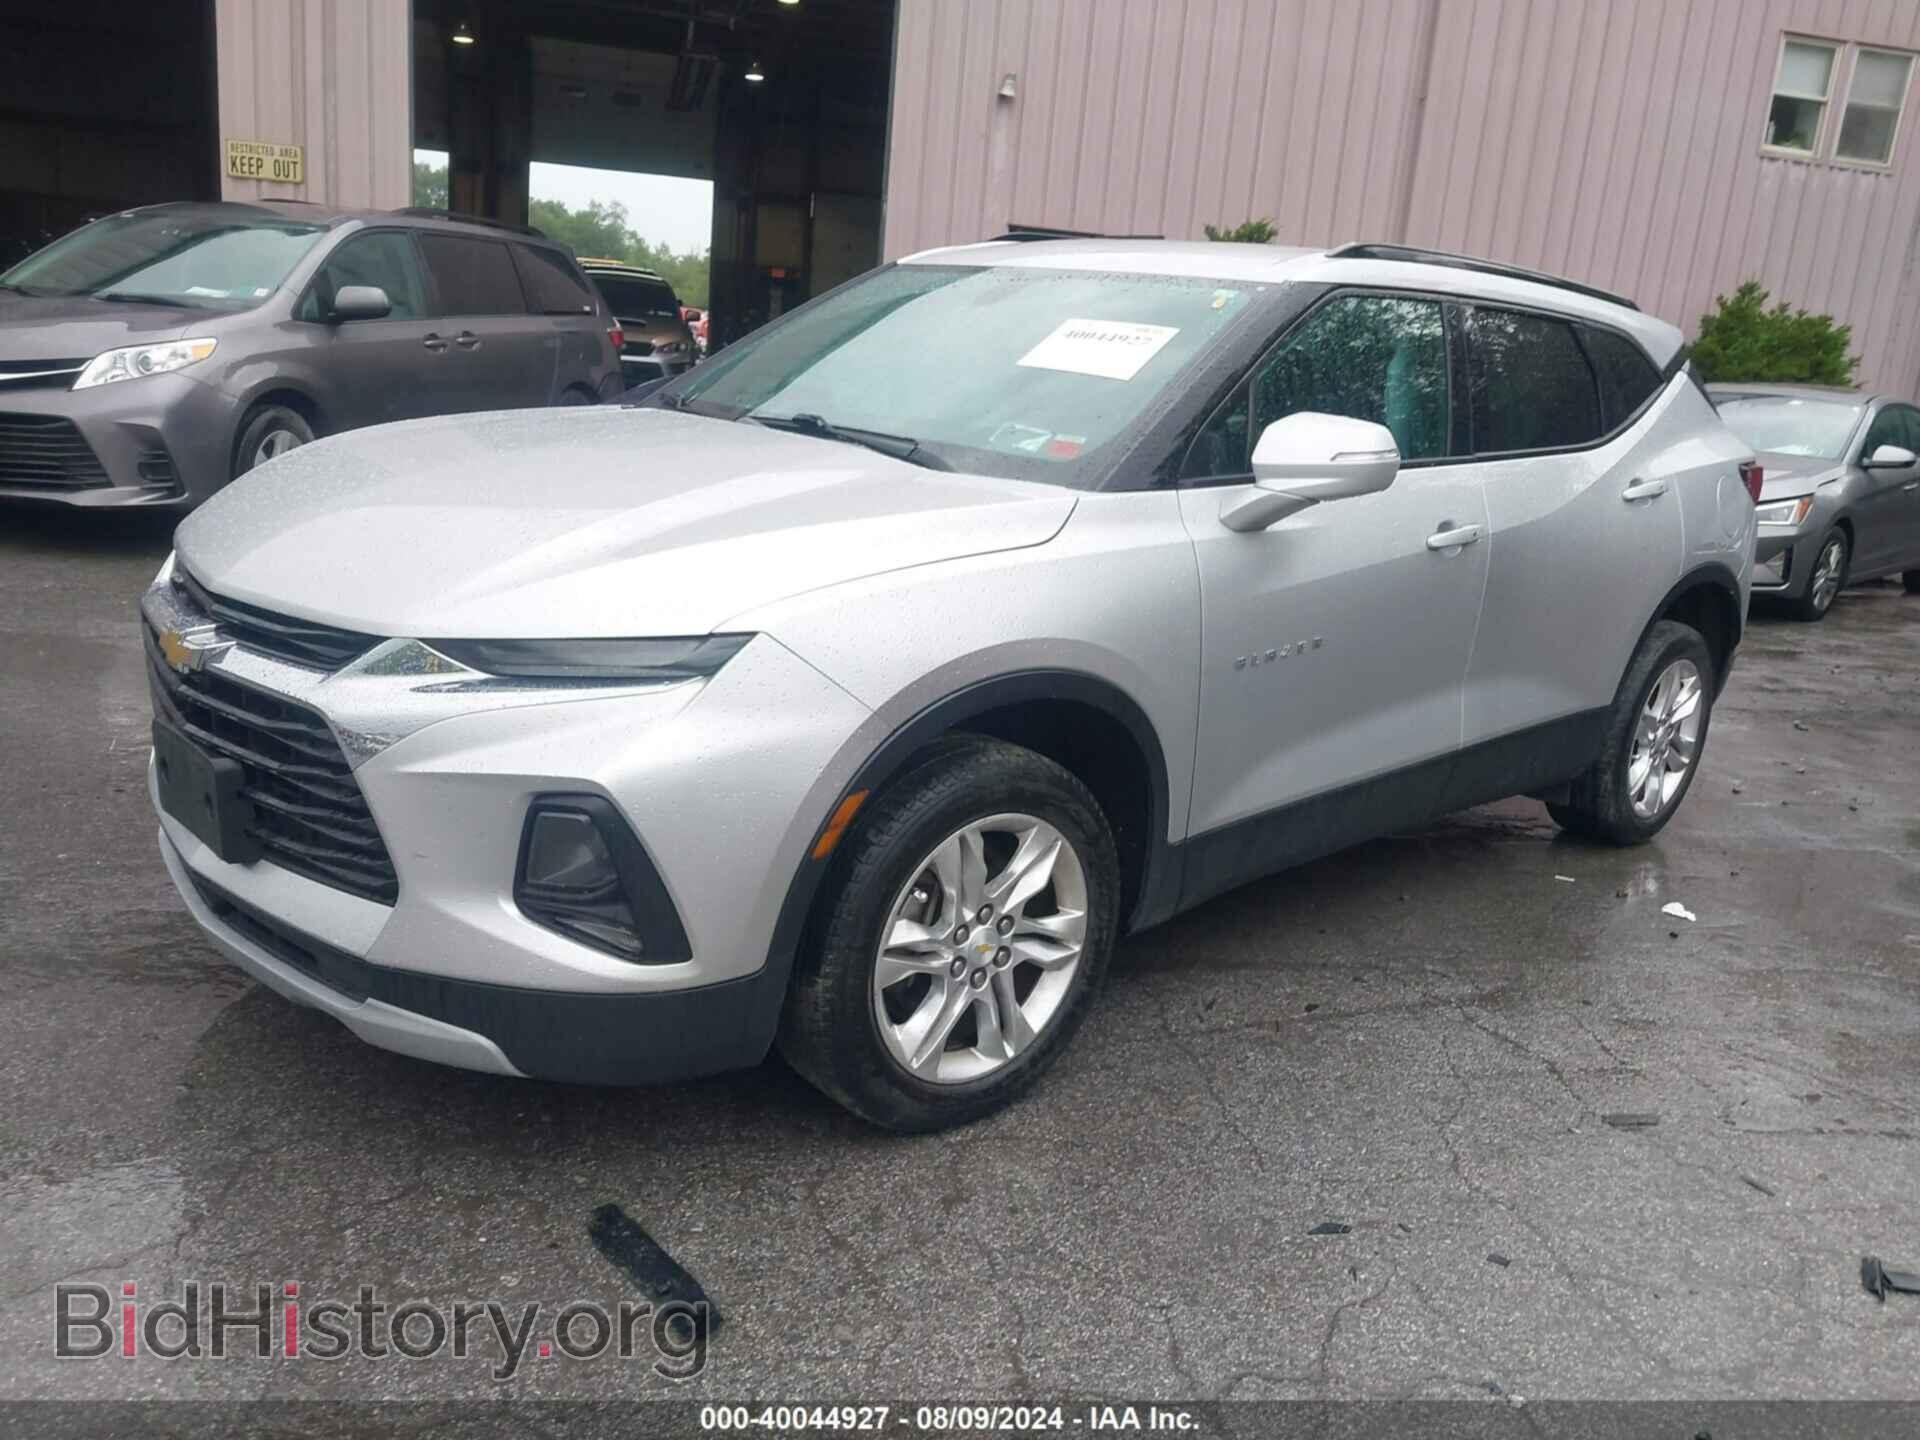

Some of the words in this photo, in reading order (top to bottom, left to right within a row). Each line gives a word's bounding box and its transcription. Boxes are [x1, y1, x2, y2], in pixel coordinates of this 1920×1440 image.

[279, 147, 298, 158] AREA
[230, 155, 264, 176] KEEP
[273, 158, 299, 179] OUT
